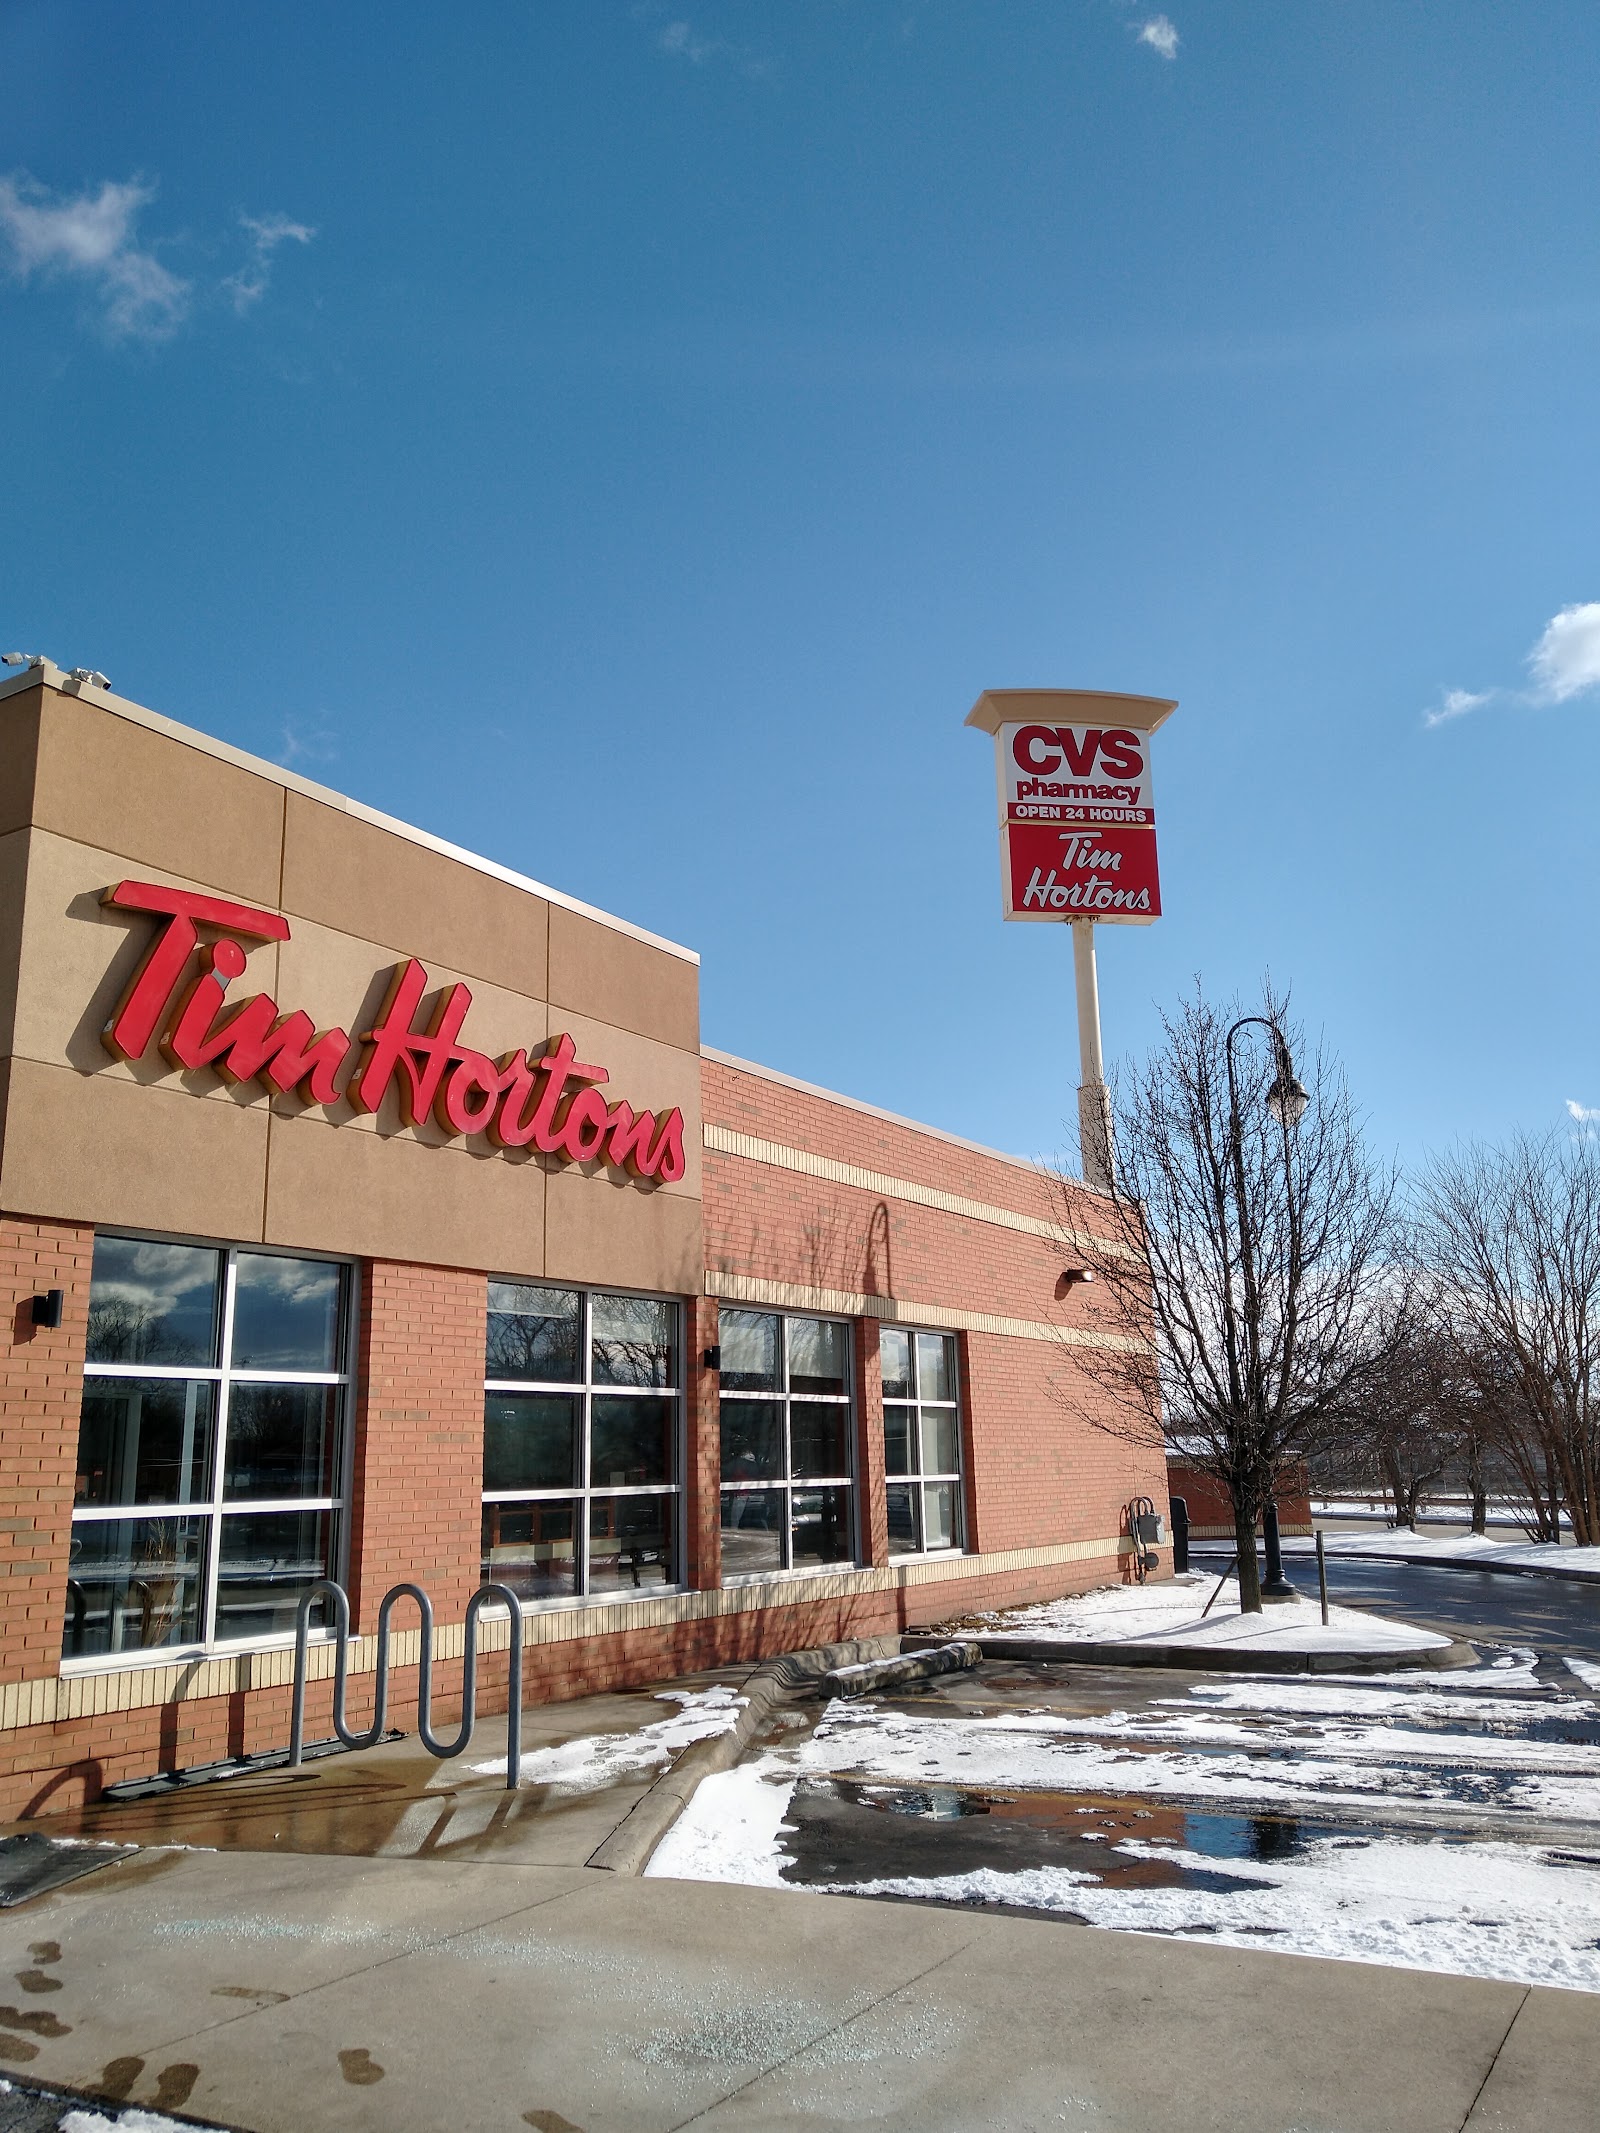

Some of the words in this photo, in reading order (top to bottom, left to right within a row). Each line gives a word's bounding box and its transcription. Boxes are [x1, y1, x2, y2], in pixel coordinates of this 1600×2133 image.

[1012, 725, 1144, 779] CVS
[1016, 777, 1141, 805] pharmacy
[1015, 804, 1061, 819] OPEN
[1065, 809, 1085, 820] 24
[1089, 809, 1147, 822] HOURS
[1058, 831, 1123, 871] Tim
[1022, 866, 1150, 909] Hortons
[103, 880, 352, 1106] Tim
[347, 958, 686, 1184] Hortons
